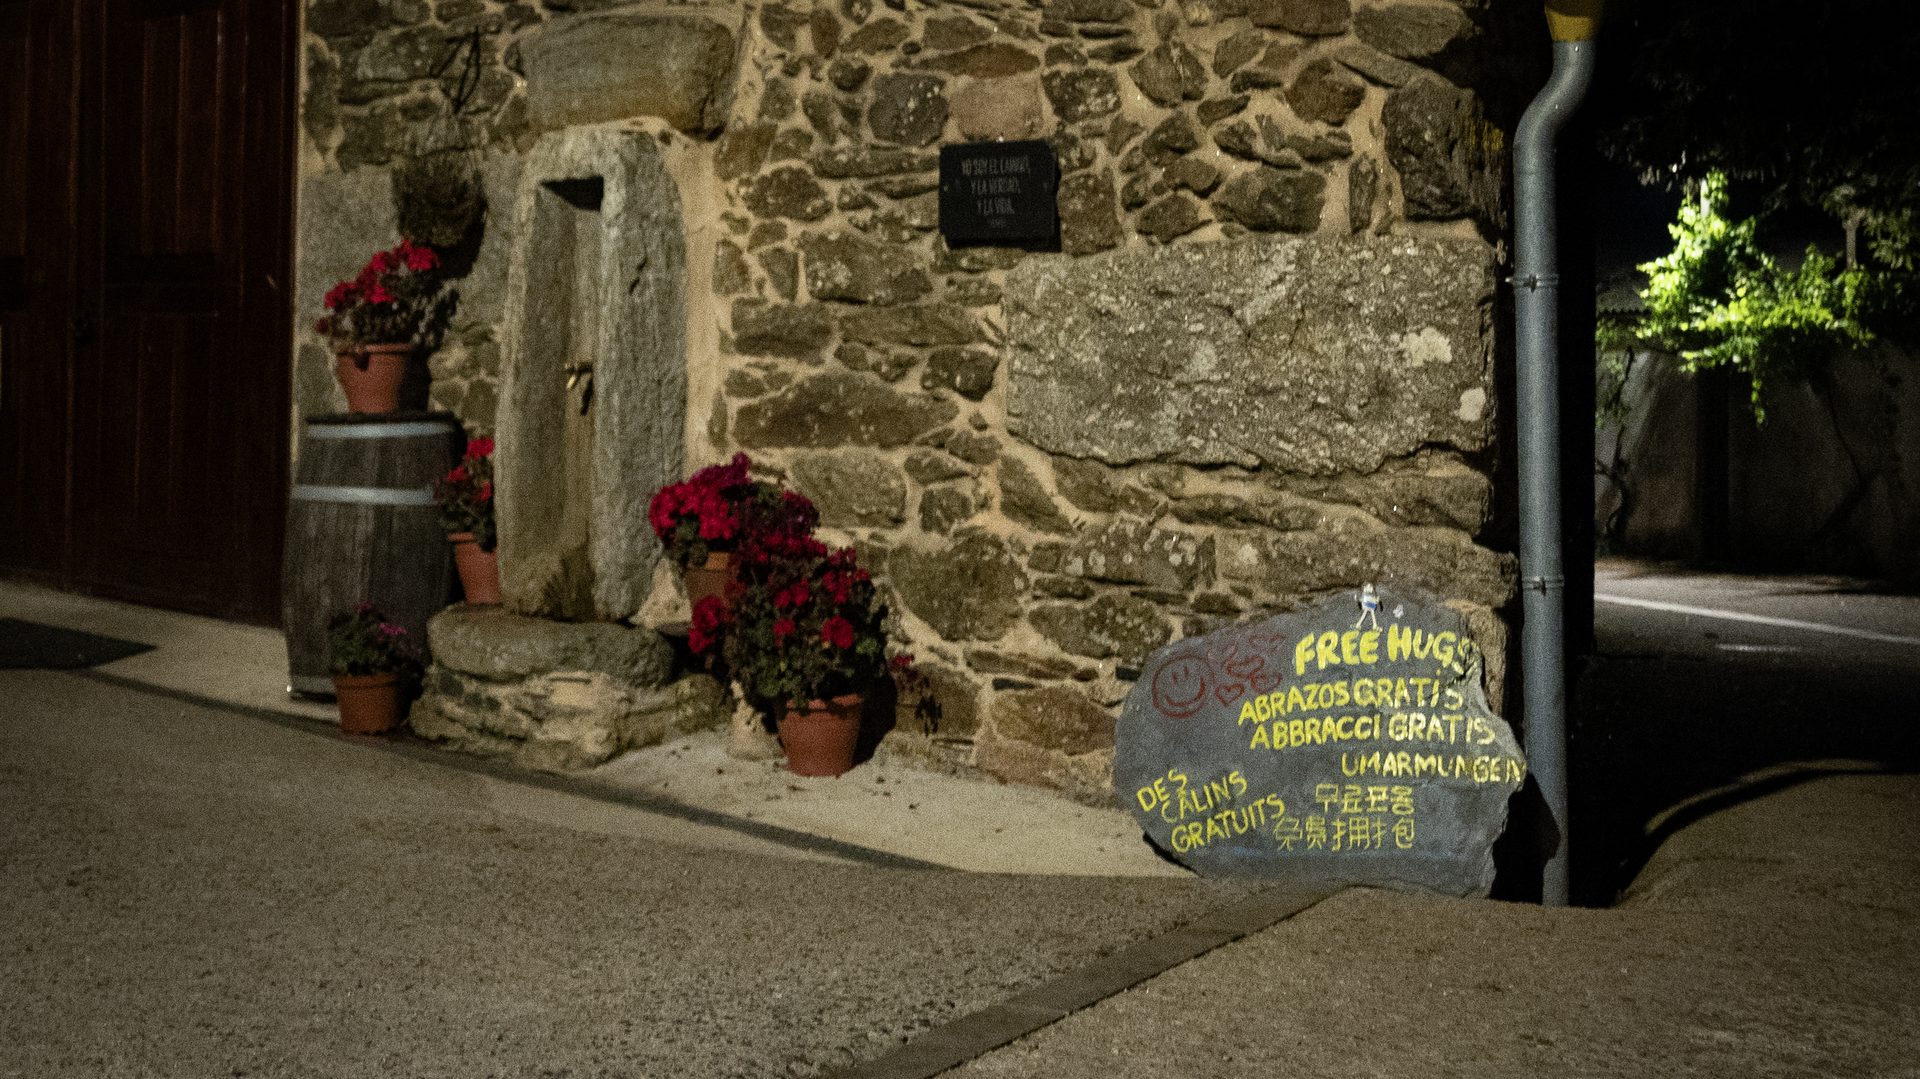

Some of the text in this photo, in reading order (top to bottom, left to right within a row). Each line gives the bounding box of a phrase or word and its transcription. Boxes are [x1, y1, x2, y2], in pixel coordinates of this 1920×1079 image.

[1295, 630, 1381, 676] FREE
[1237, 681, 1351, 726] ABRAZOS
[1250, 712, 1497, 750] ABBRACCI GRATIS
[1136, 768, 1188, 812] DES
[1171, 793, 1286, 853] GRATUITS
